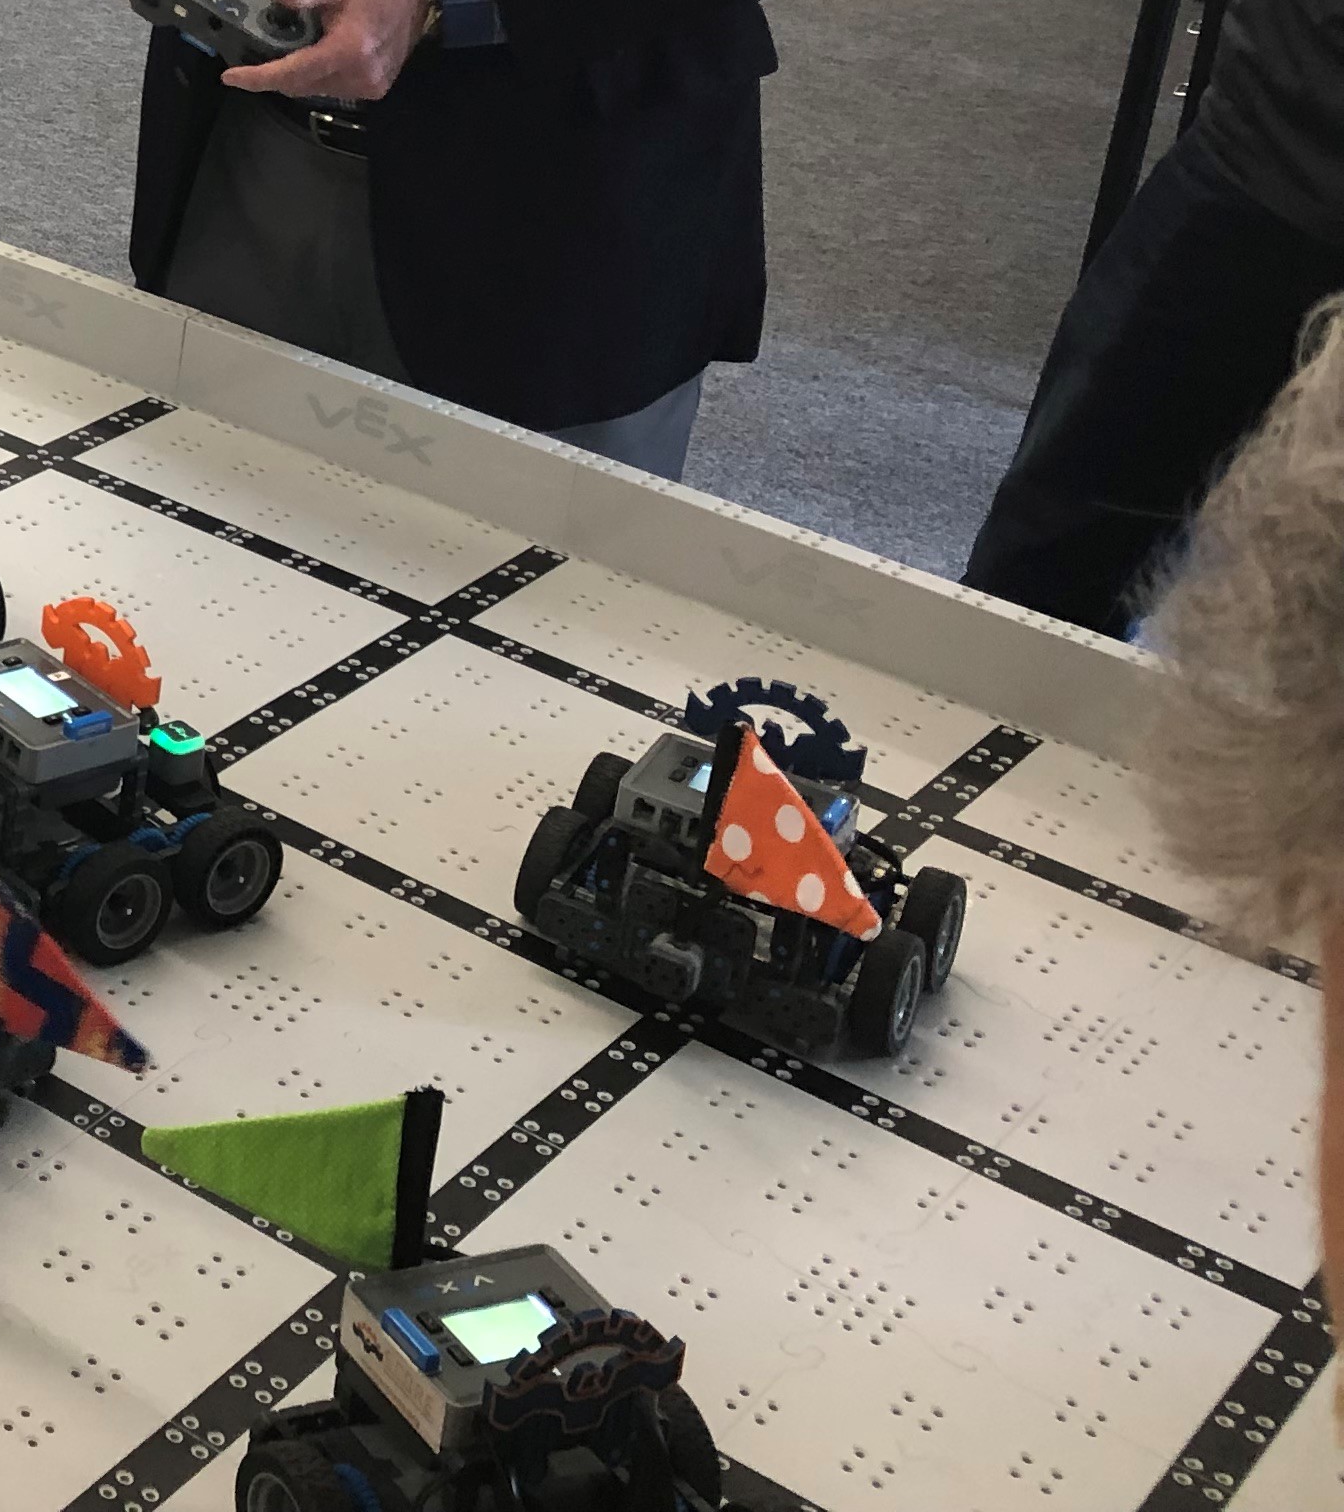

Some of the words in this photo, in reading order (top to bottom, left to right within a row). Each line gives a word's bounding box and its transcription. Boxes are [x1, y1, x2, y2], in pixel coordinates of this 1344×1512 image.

[304, 391, 437, 467] VEX
[720, 546, 876, 627] VEX
[433, 1273, 496, 1295] VX
